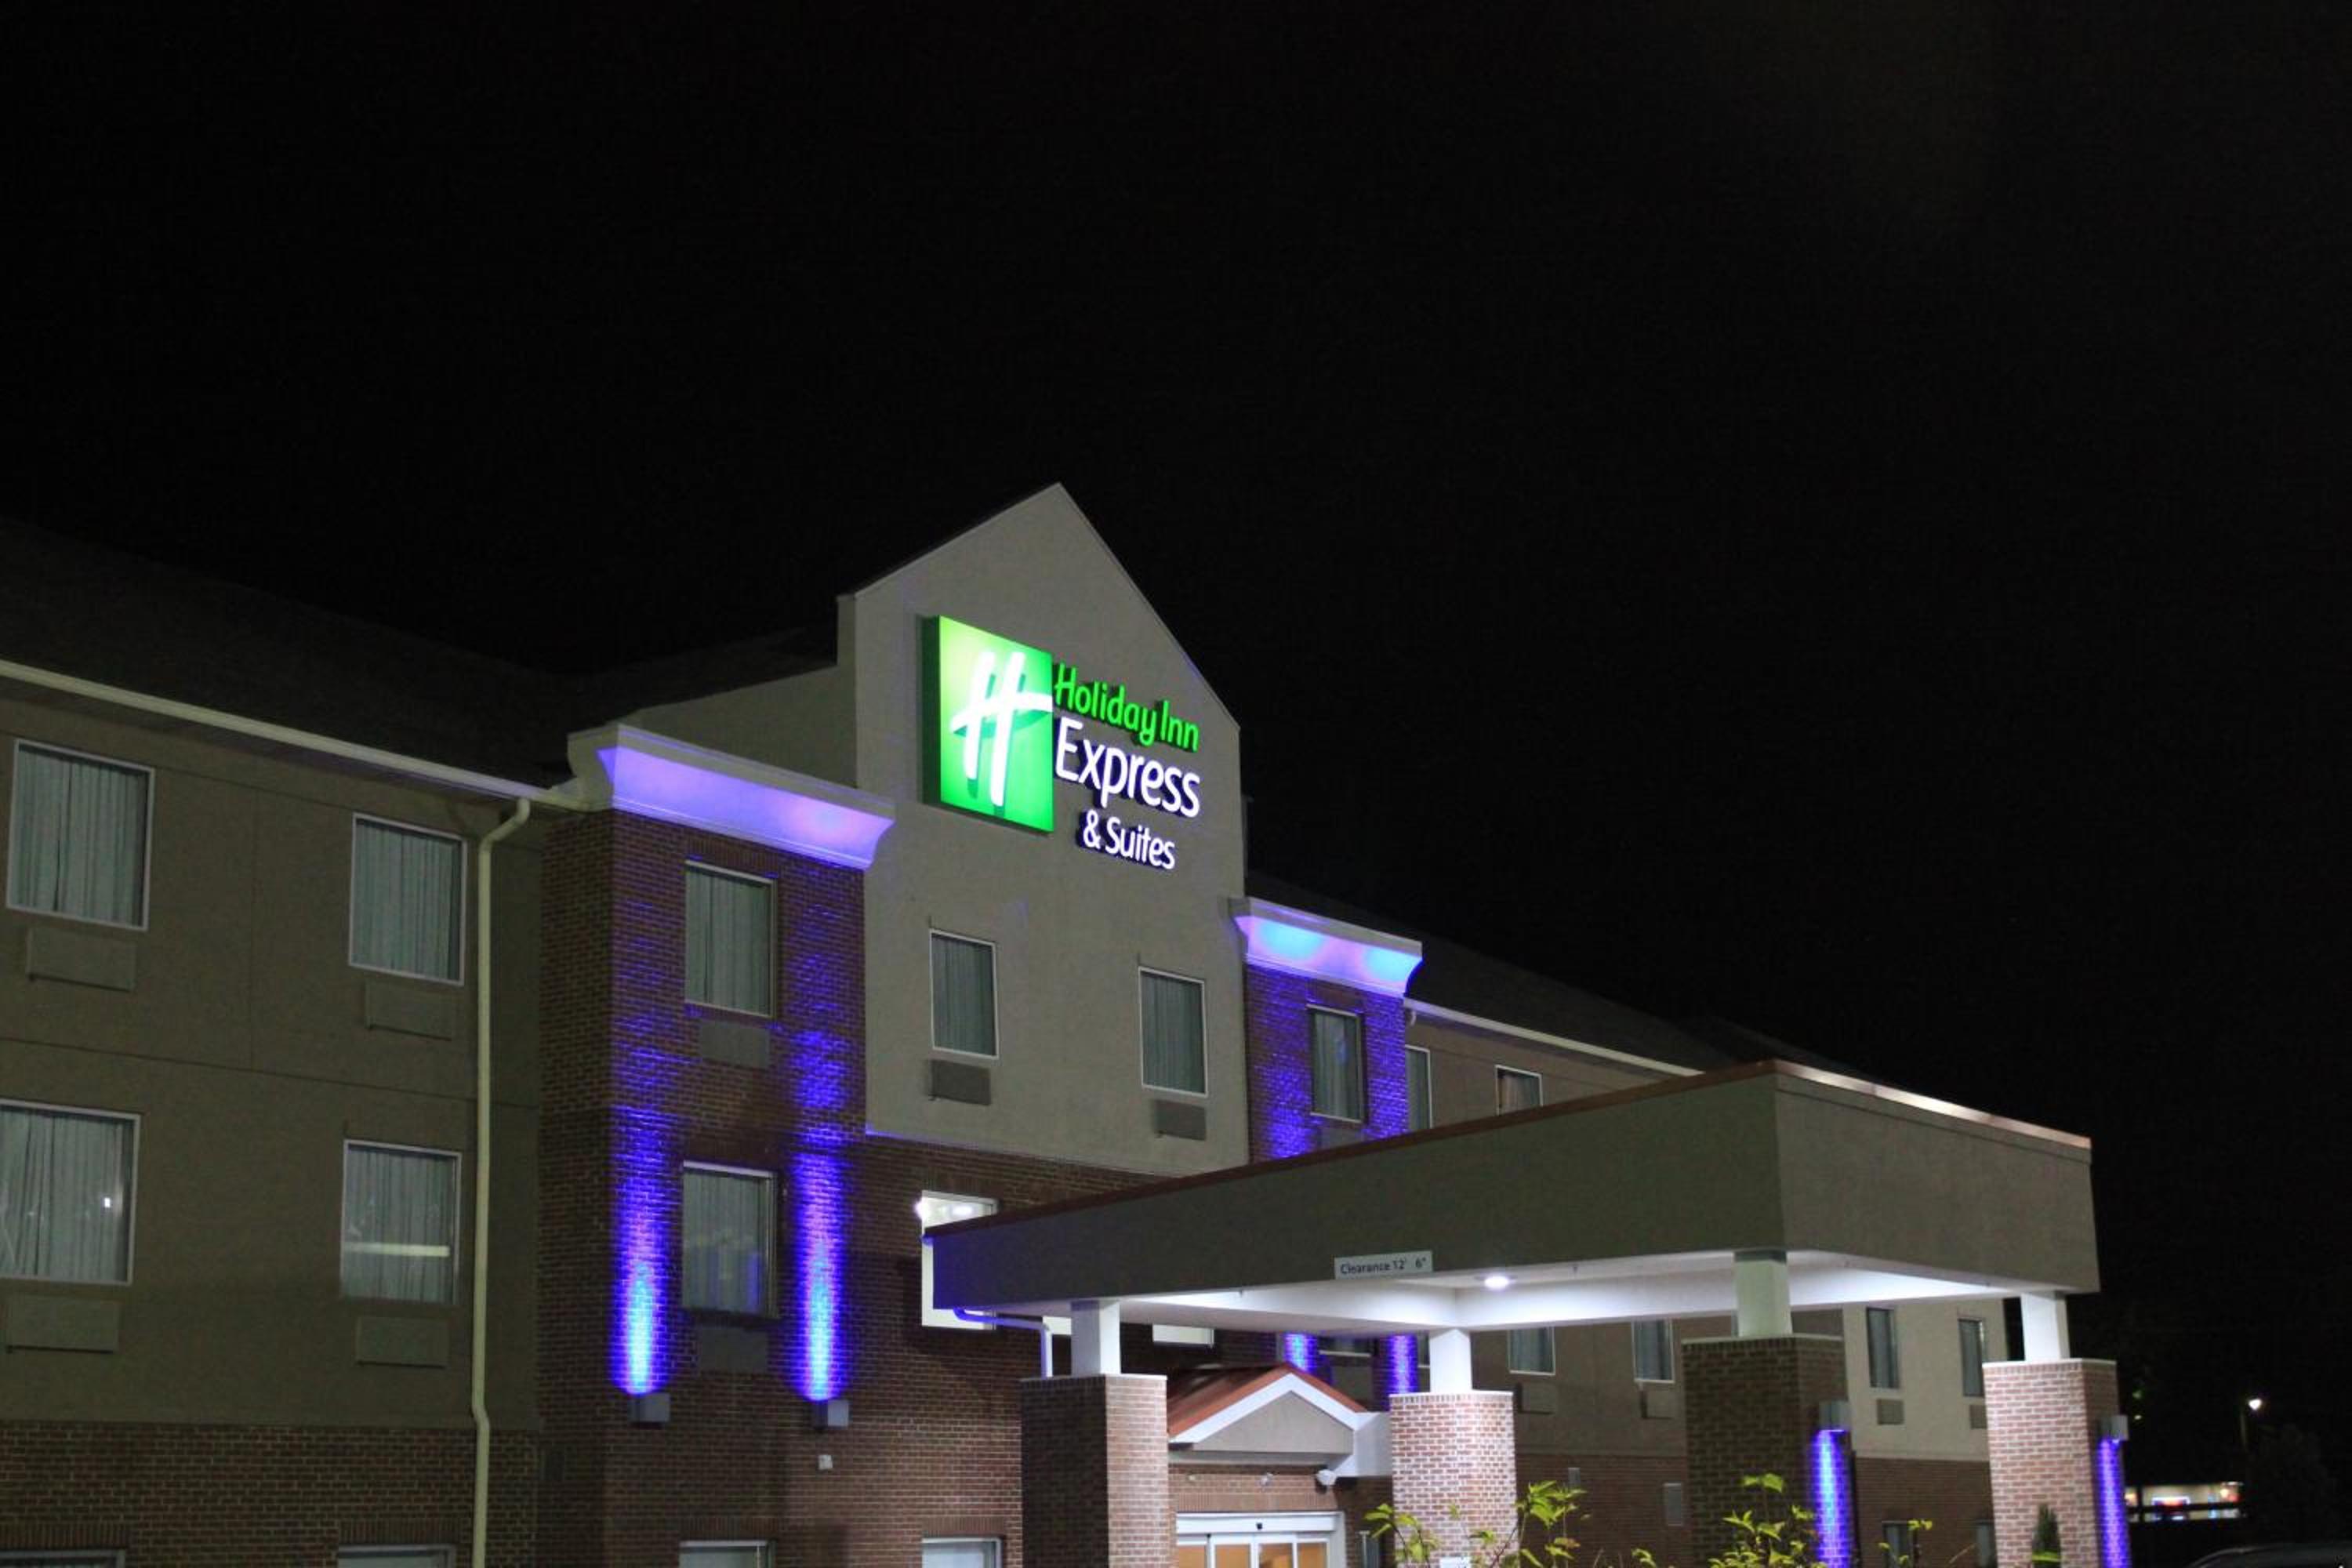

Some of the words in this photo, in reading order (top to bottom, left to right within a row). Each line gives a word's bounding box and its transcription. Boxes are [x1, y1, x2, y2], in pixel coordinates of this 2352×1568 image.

[1054, 662, 1156, 746] Holiday
[1163, 699, 1200, 753] Inn
[1054, 716, 1201, 818] Express
[1081, 809, 1102, 850] &
[1105, 815, 1176, 870] Suites
[1340, 1261, 1391, 1275] Clearance
